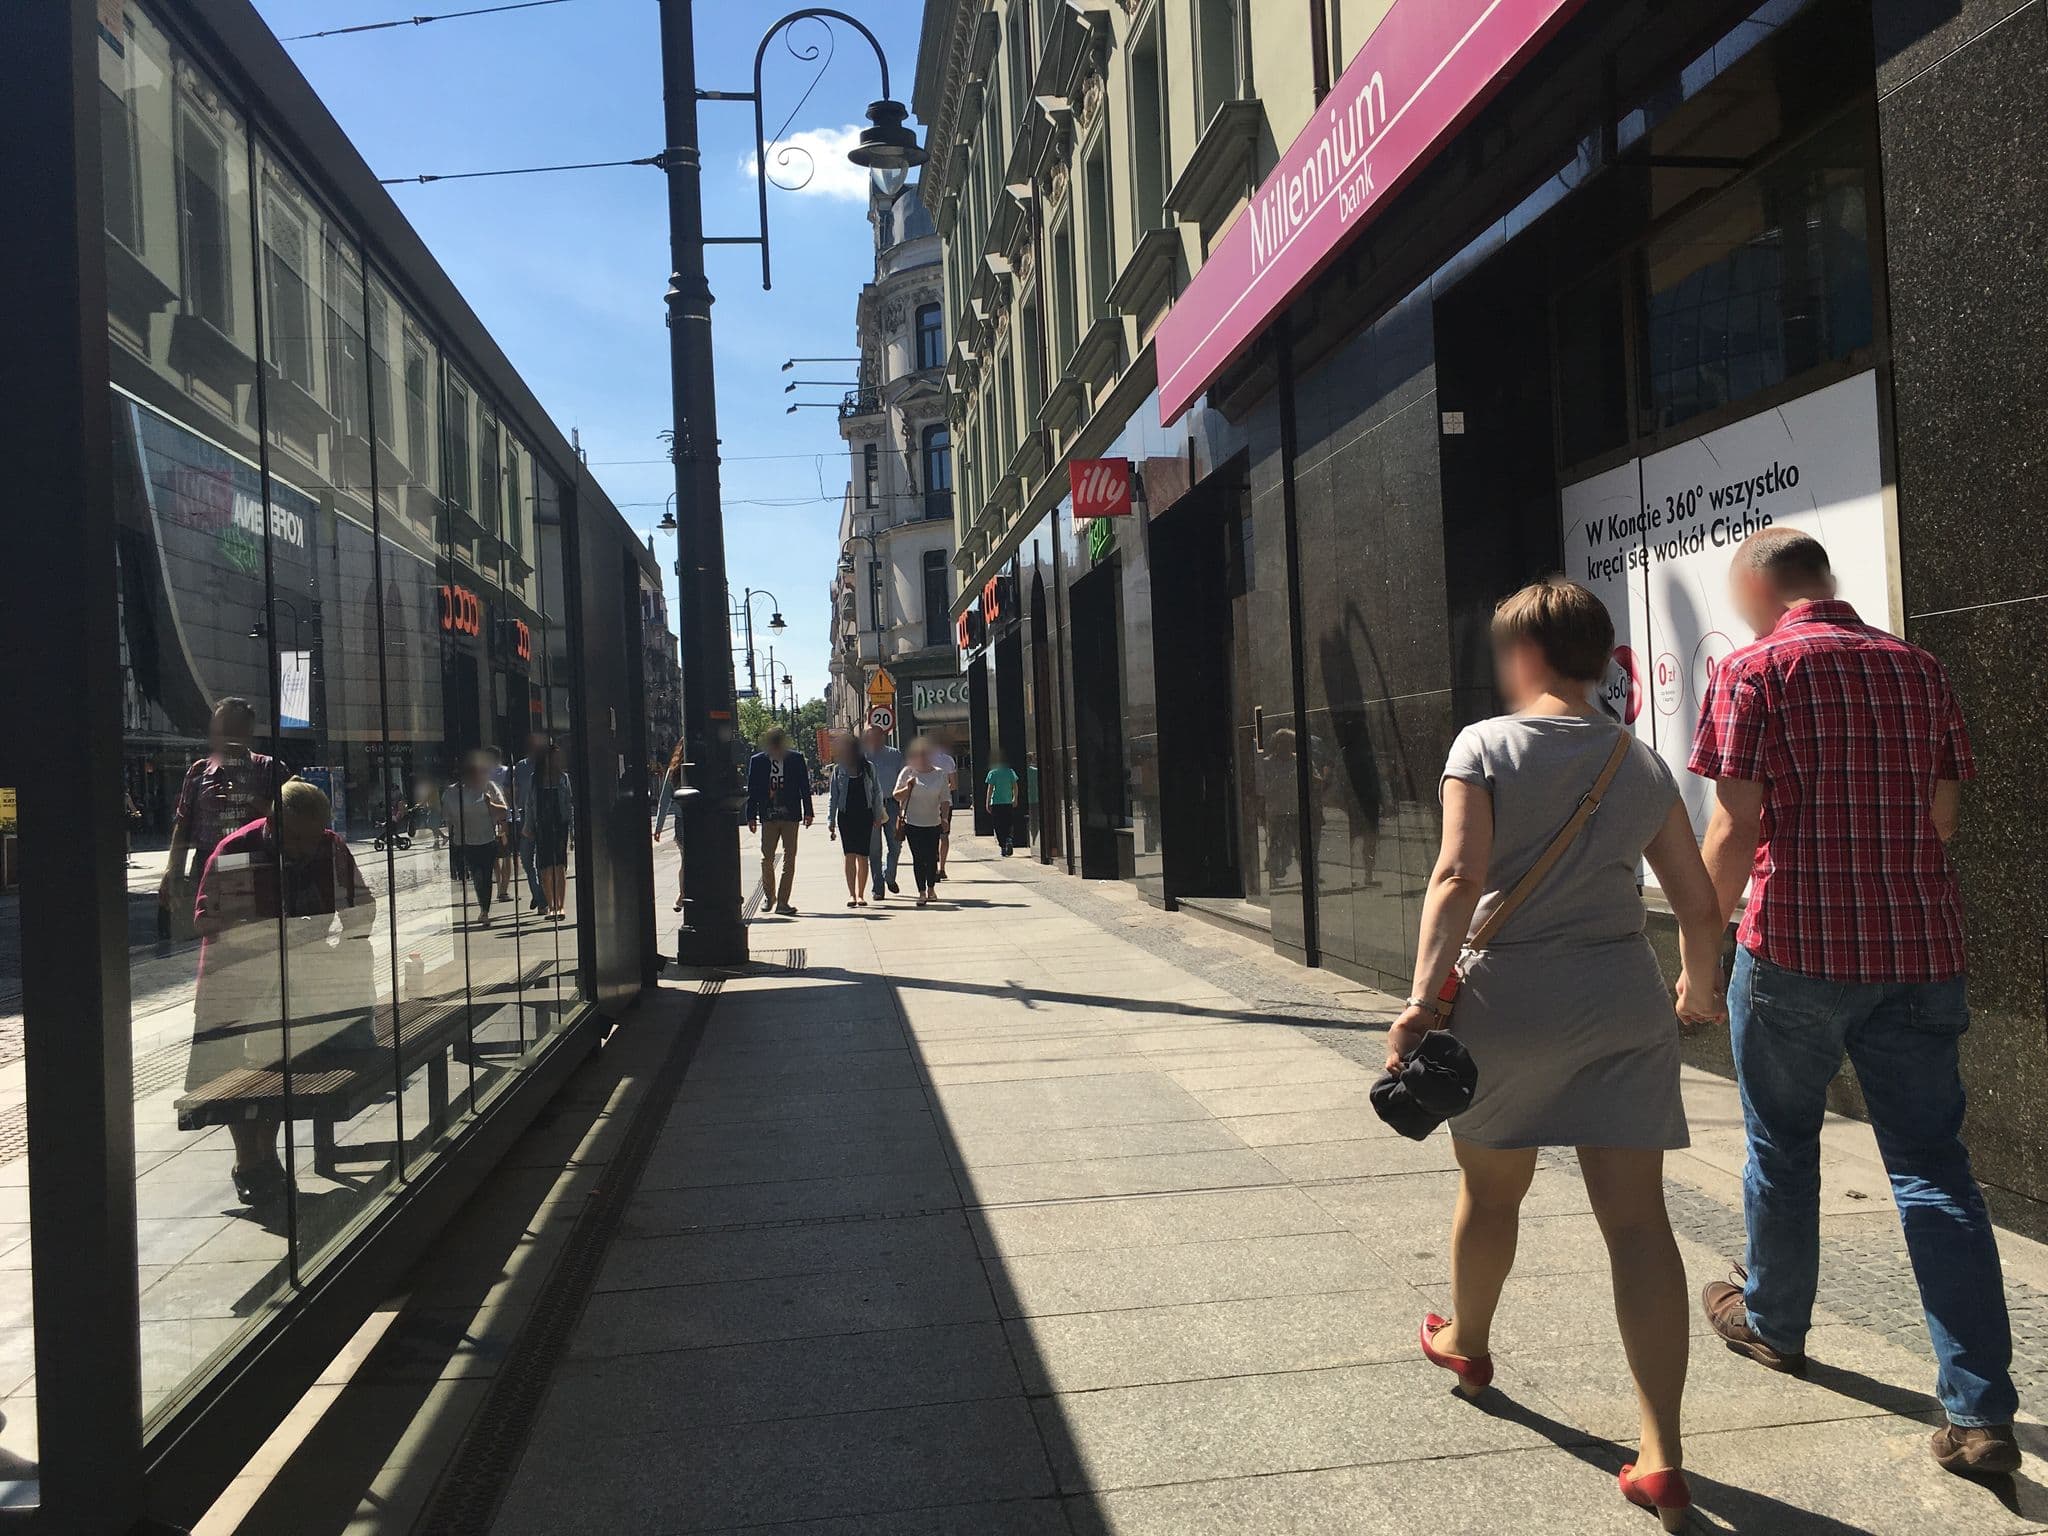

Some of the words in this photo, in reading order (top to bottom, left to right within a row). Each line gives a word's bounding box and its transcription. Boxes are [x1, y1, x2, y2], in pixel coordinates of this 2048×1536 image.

[1250, 70, 1388, 275] Millennium
[1338, 154, 1375, 223] bank
[1077, 466, 1127, 511] illy
[1585, 518, 1604, 547] W
[1608, 503, 1662, 542] Koncie
[1666, 485, 1703, 524] 360°
[1709, 461, 1800, 511] wszystko
[1587, 547, 1624, 582] kręci
[1628, 542, 1650, 572] się
[1654, 524, 1706, 562] wokół
[1710, 507, 1773, 548] Ciebie
[873, 713, 891, 726] 20
